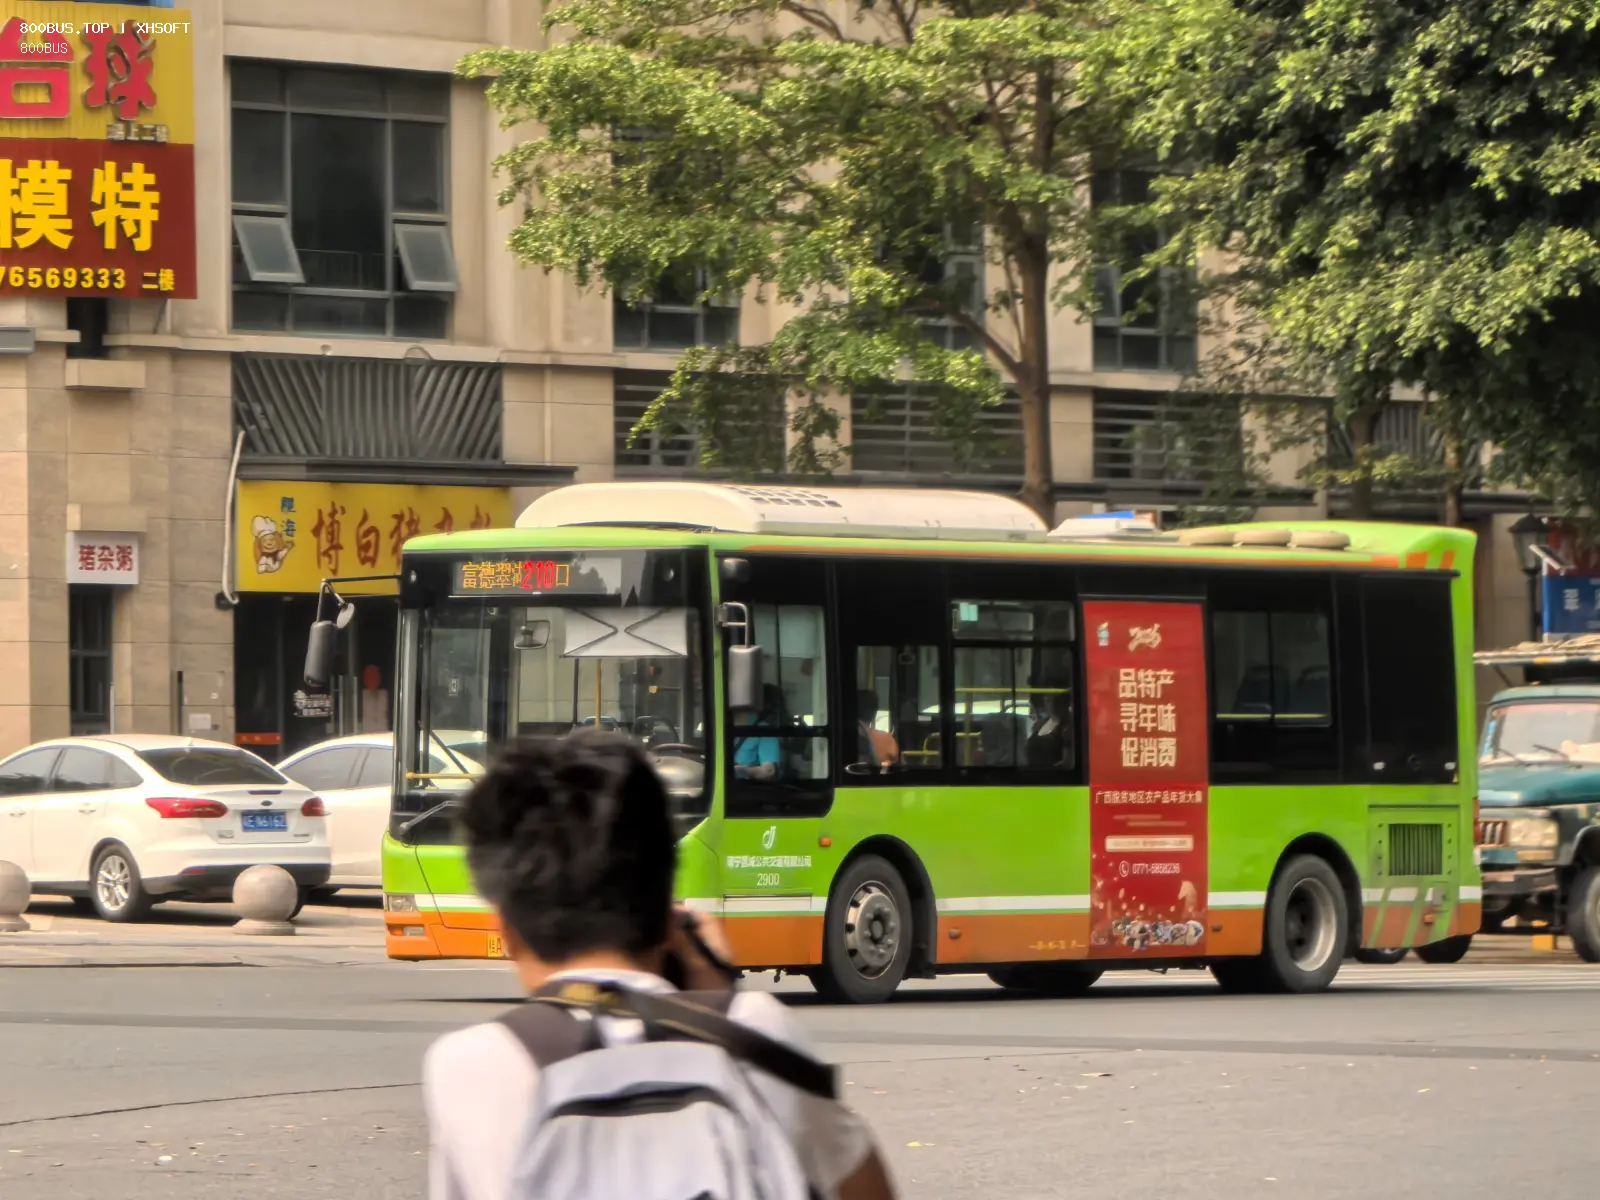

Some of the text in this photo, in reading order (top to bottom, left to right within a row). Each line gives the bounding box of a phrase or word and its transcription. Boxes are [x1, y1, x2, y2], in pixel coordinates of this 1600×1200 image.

[0, 159, 160, 251] 模特
[78, 545, 133, 571] 猪杂粥
[1119, 668, 1175, 698] 品特产
[1120, 703, 1176, 732] 寻年味
[1121, 737, 1177, 767] 促消费
[757, 873, 780, 886] 2900
